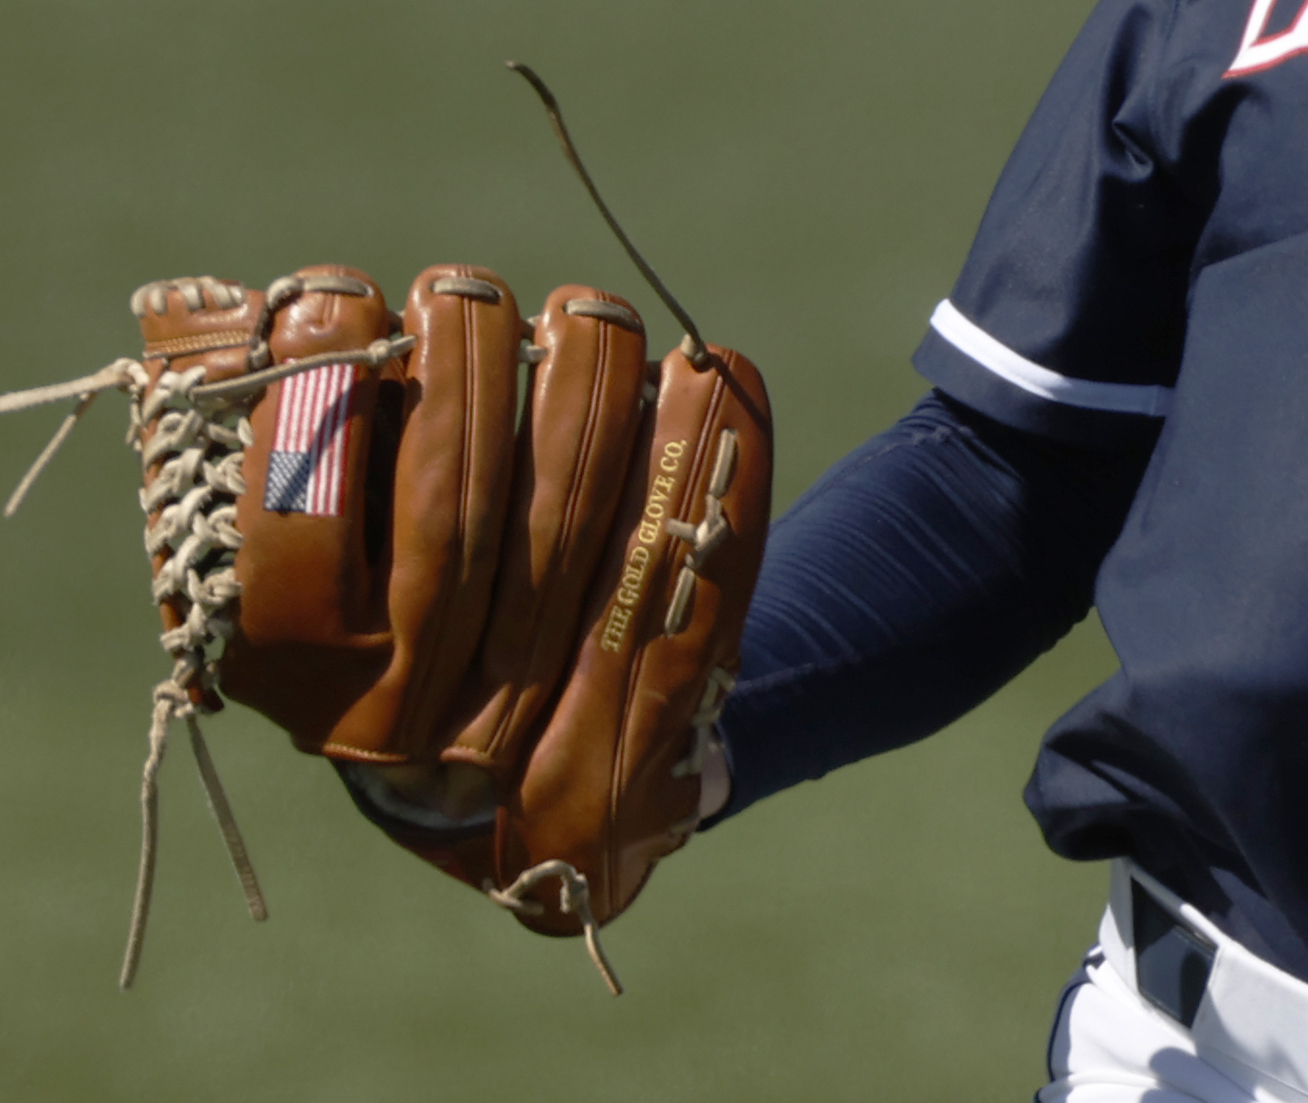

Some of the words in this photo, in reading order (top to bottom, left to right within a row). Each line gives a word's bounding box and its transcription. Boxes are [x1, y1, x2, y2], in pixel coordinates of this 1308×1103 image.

[660, 439, 687, 472] CO.
[638, 474, 676, 544] GLOVE
[616, 546, 649, 606] GOLD
[601, 605, 632, 653] THE
